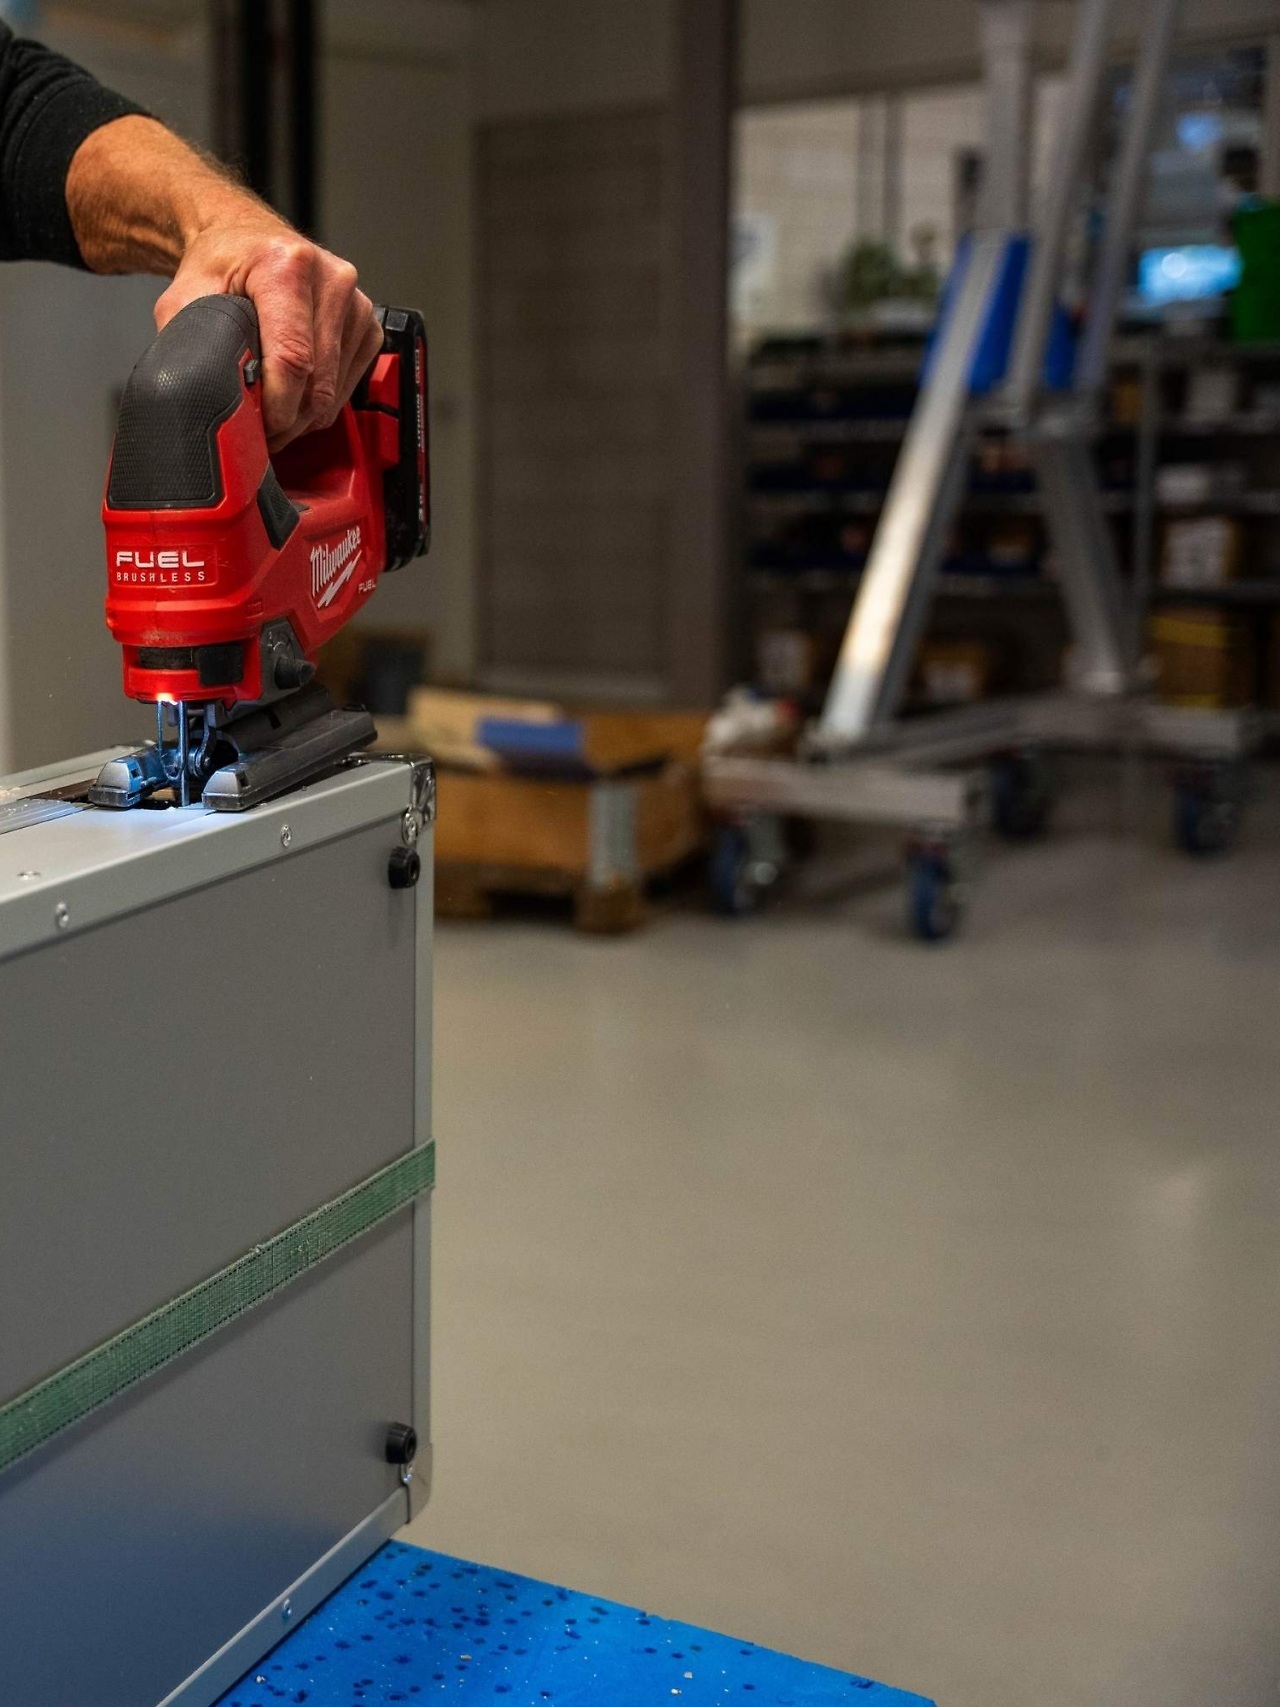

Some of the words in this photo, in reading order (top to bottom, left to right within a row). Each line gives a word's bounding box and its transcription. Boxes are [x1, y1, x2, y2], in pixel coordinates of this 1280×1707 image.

[116, 551, 205, 568] FUEL
[310, 526, 361, 598] Milwaukee
[116, 571, 205, 582] BRUSHLESS
[358, 578, 377, 595] FUEL
